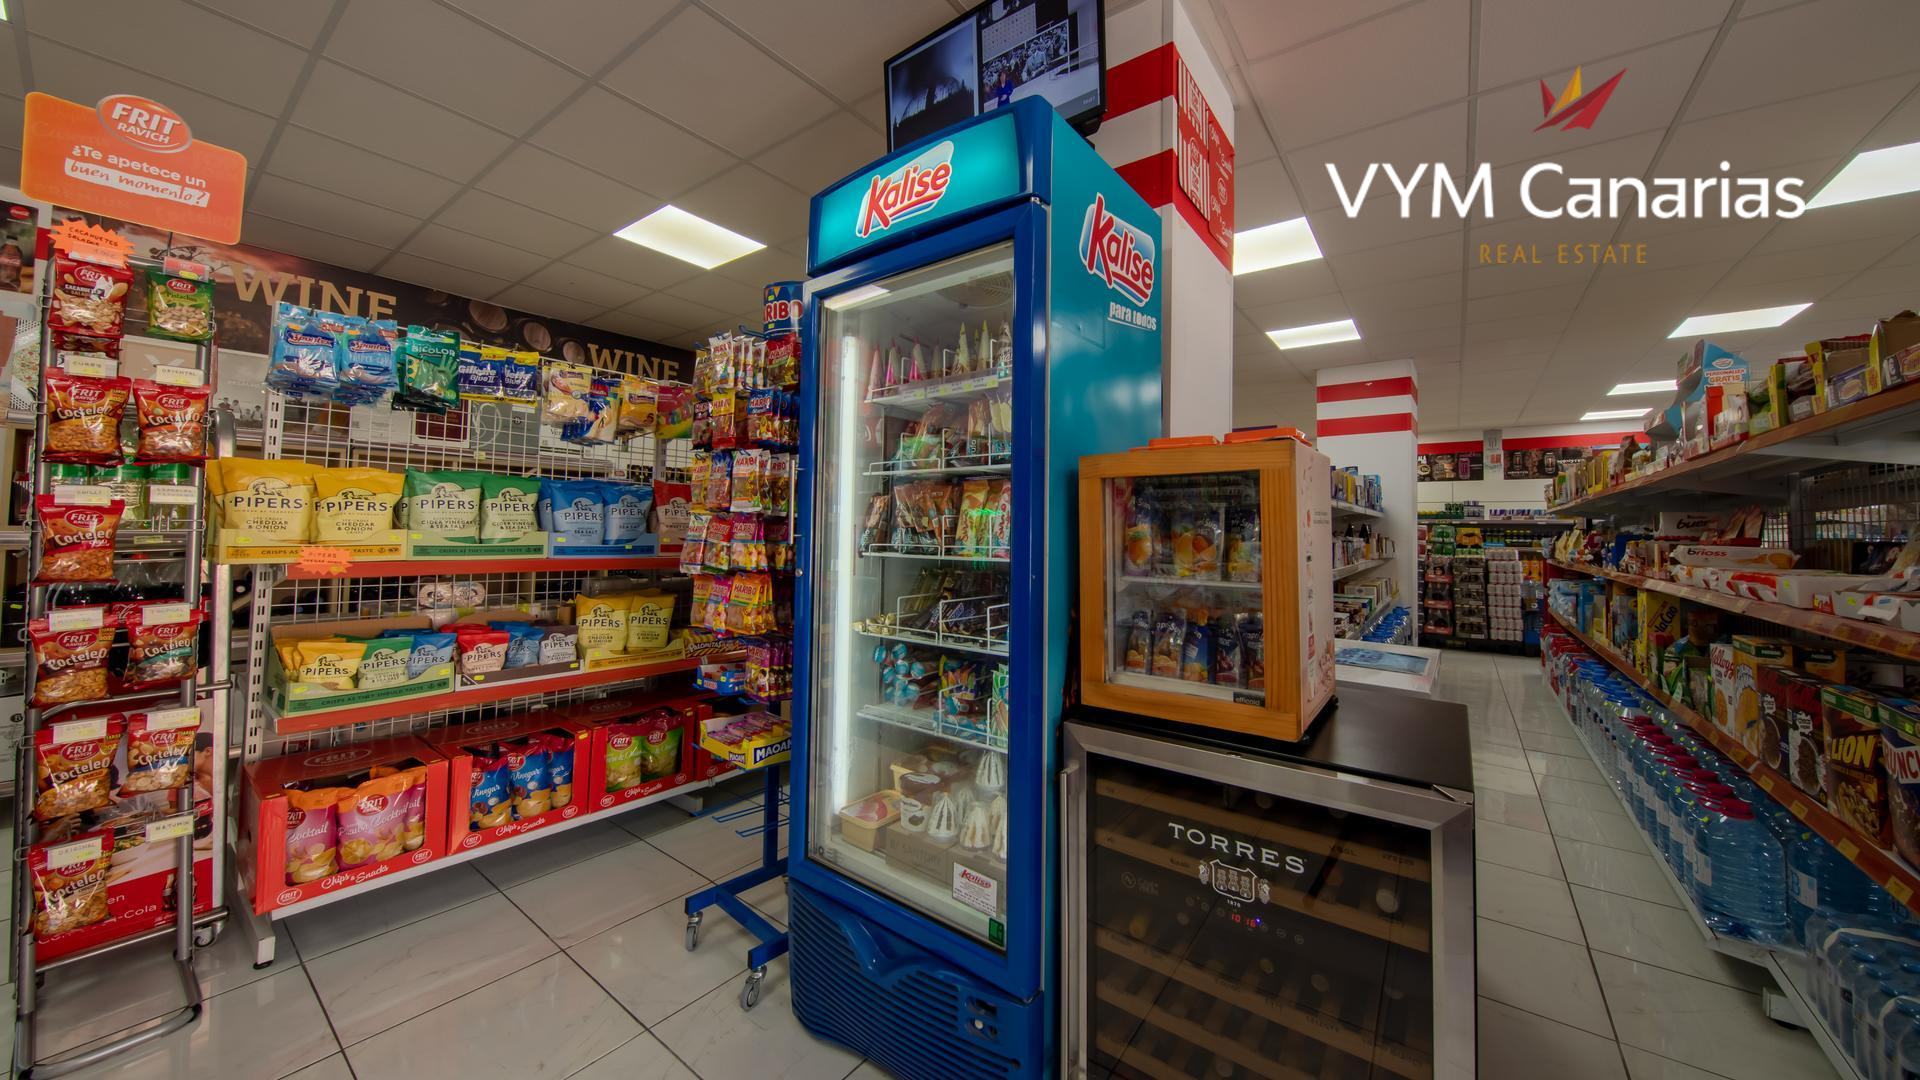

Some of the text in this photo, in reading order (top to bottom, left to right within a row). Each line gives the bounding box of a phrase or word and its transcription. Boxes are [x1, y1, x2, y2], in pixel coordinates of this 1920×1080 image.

[111, 102, 181, 135] FRIT
[117, 122, 170, 144] RAVICH
[70, 163, 110, 181] buen
[108, 155, 181, 181] apetece
[185, 175, 206, 188] un
[862, 162, 951, 237] Kalise
[1086, 194, 1154, 290] Kalise
[229, 261, 398, 321] WINE
[1108, 301, 1131, 319] para
[352, 341, 391, 353] Spontex
[411, 346, 456, 357] BICOLOR
[587, 344, 680, 381] WINE
[1710, 375, 1740, 383] GRATIS
[73, 388, 101, 397] FRIT
[162, 397, 187, 405] FRIT
[234, 496, 304, 509] PIPERS
[326, 501, 388, 512] PIPERS
[420, 499, 475, 510] PIPERS
[491, 502, 537, 512] PIPERS
[70, 513, 99, 521] FRIT
[564, 512, 604, 521] PIPERS
[1687, 547, 1728, 557] brioss
[734, 583, 757, 595] HARIBO
[581, 618, 621, 628] PIPERS
[631, 616, 668, 625] PIPERS
[156, 625, 180, 634] FRIT
[62, 634, 93, 643] FRIT
[544, 640, 577, 649] PIPERS
[407, 655, 445, 665] PIPERS
[467, 650, 502, 661] PIPERS
[363, 657, 407, 670] PIPERS
[305, 667, 349, 676] PIPERS
[66, 742, 97, 755] FRIT
[1831, 735, 1875, 769] LION
[1168, 821, 1305, 874] TORRES
[414, 852, 430, 861] FRIT
[961, 869, 992, 889] Kalise
[280, 891, 299, 900] FRIT
